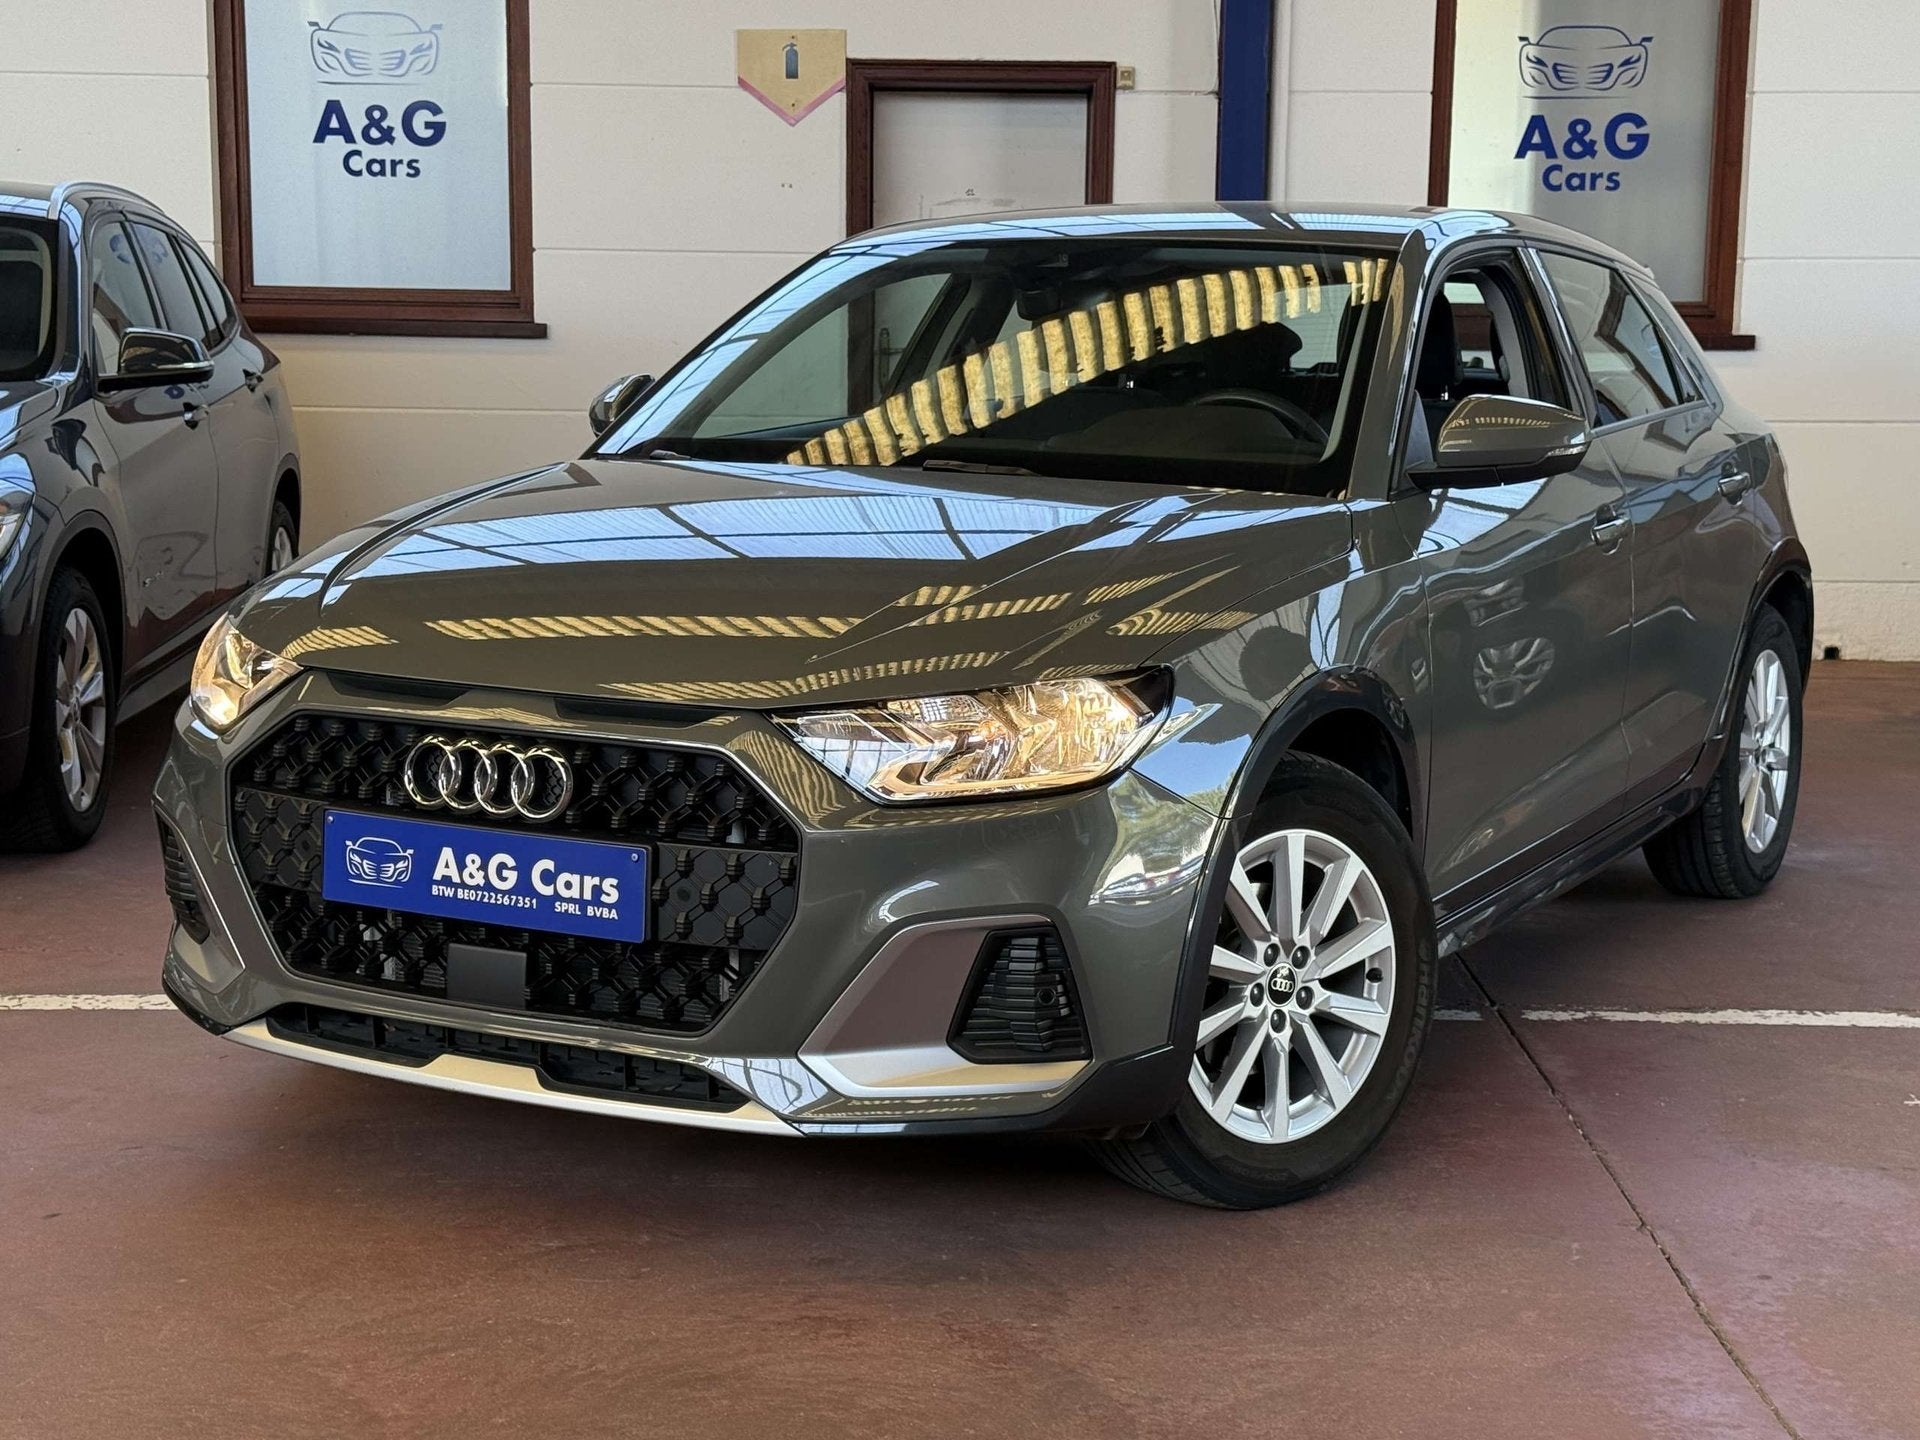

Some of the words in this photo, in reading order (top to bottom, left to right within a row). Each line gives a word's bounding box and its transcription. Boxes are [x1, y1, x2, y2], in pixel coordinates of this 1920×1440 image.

[312, 99, 447, 147] A&G
[1513, 112, 1651, 160] A&G
[342, 149, 422, 179] Cars
[1541, 164, 1622, 192] Cars
[432, 846, 519, 891] A&G
[531, 858, 620, 905] Cars
[431, 884, 456, 898] BTW
[457, 888, 537, 909] BE0722567351
[554, 901, 581, 915] SPRL
[587, 905, 619, 920] BVBA
